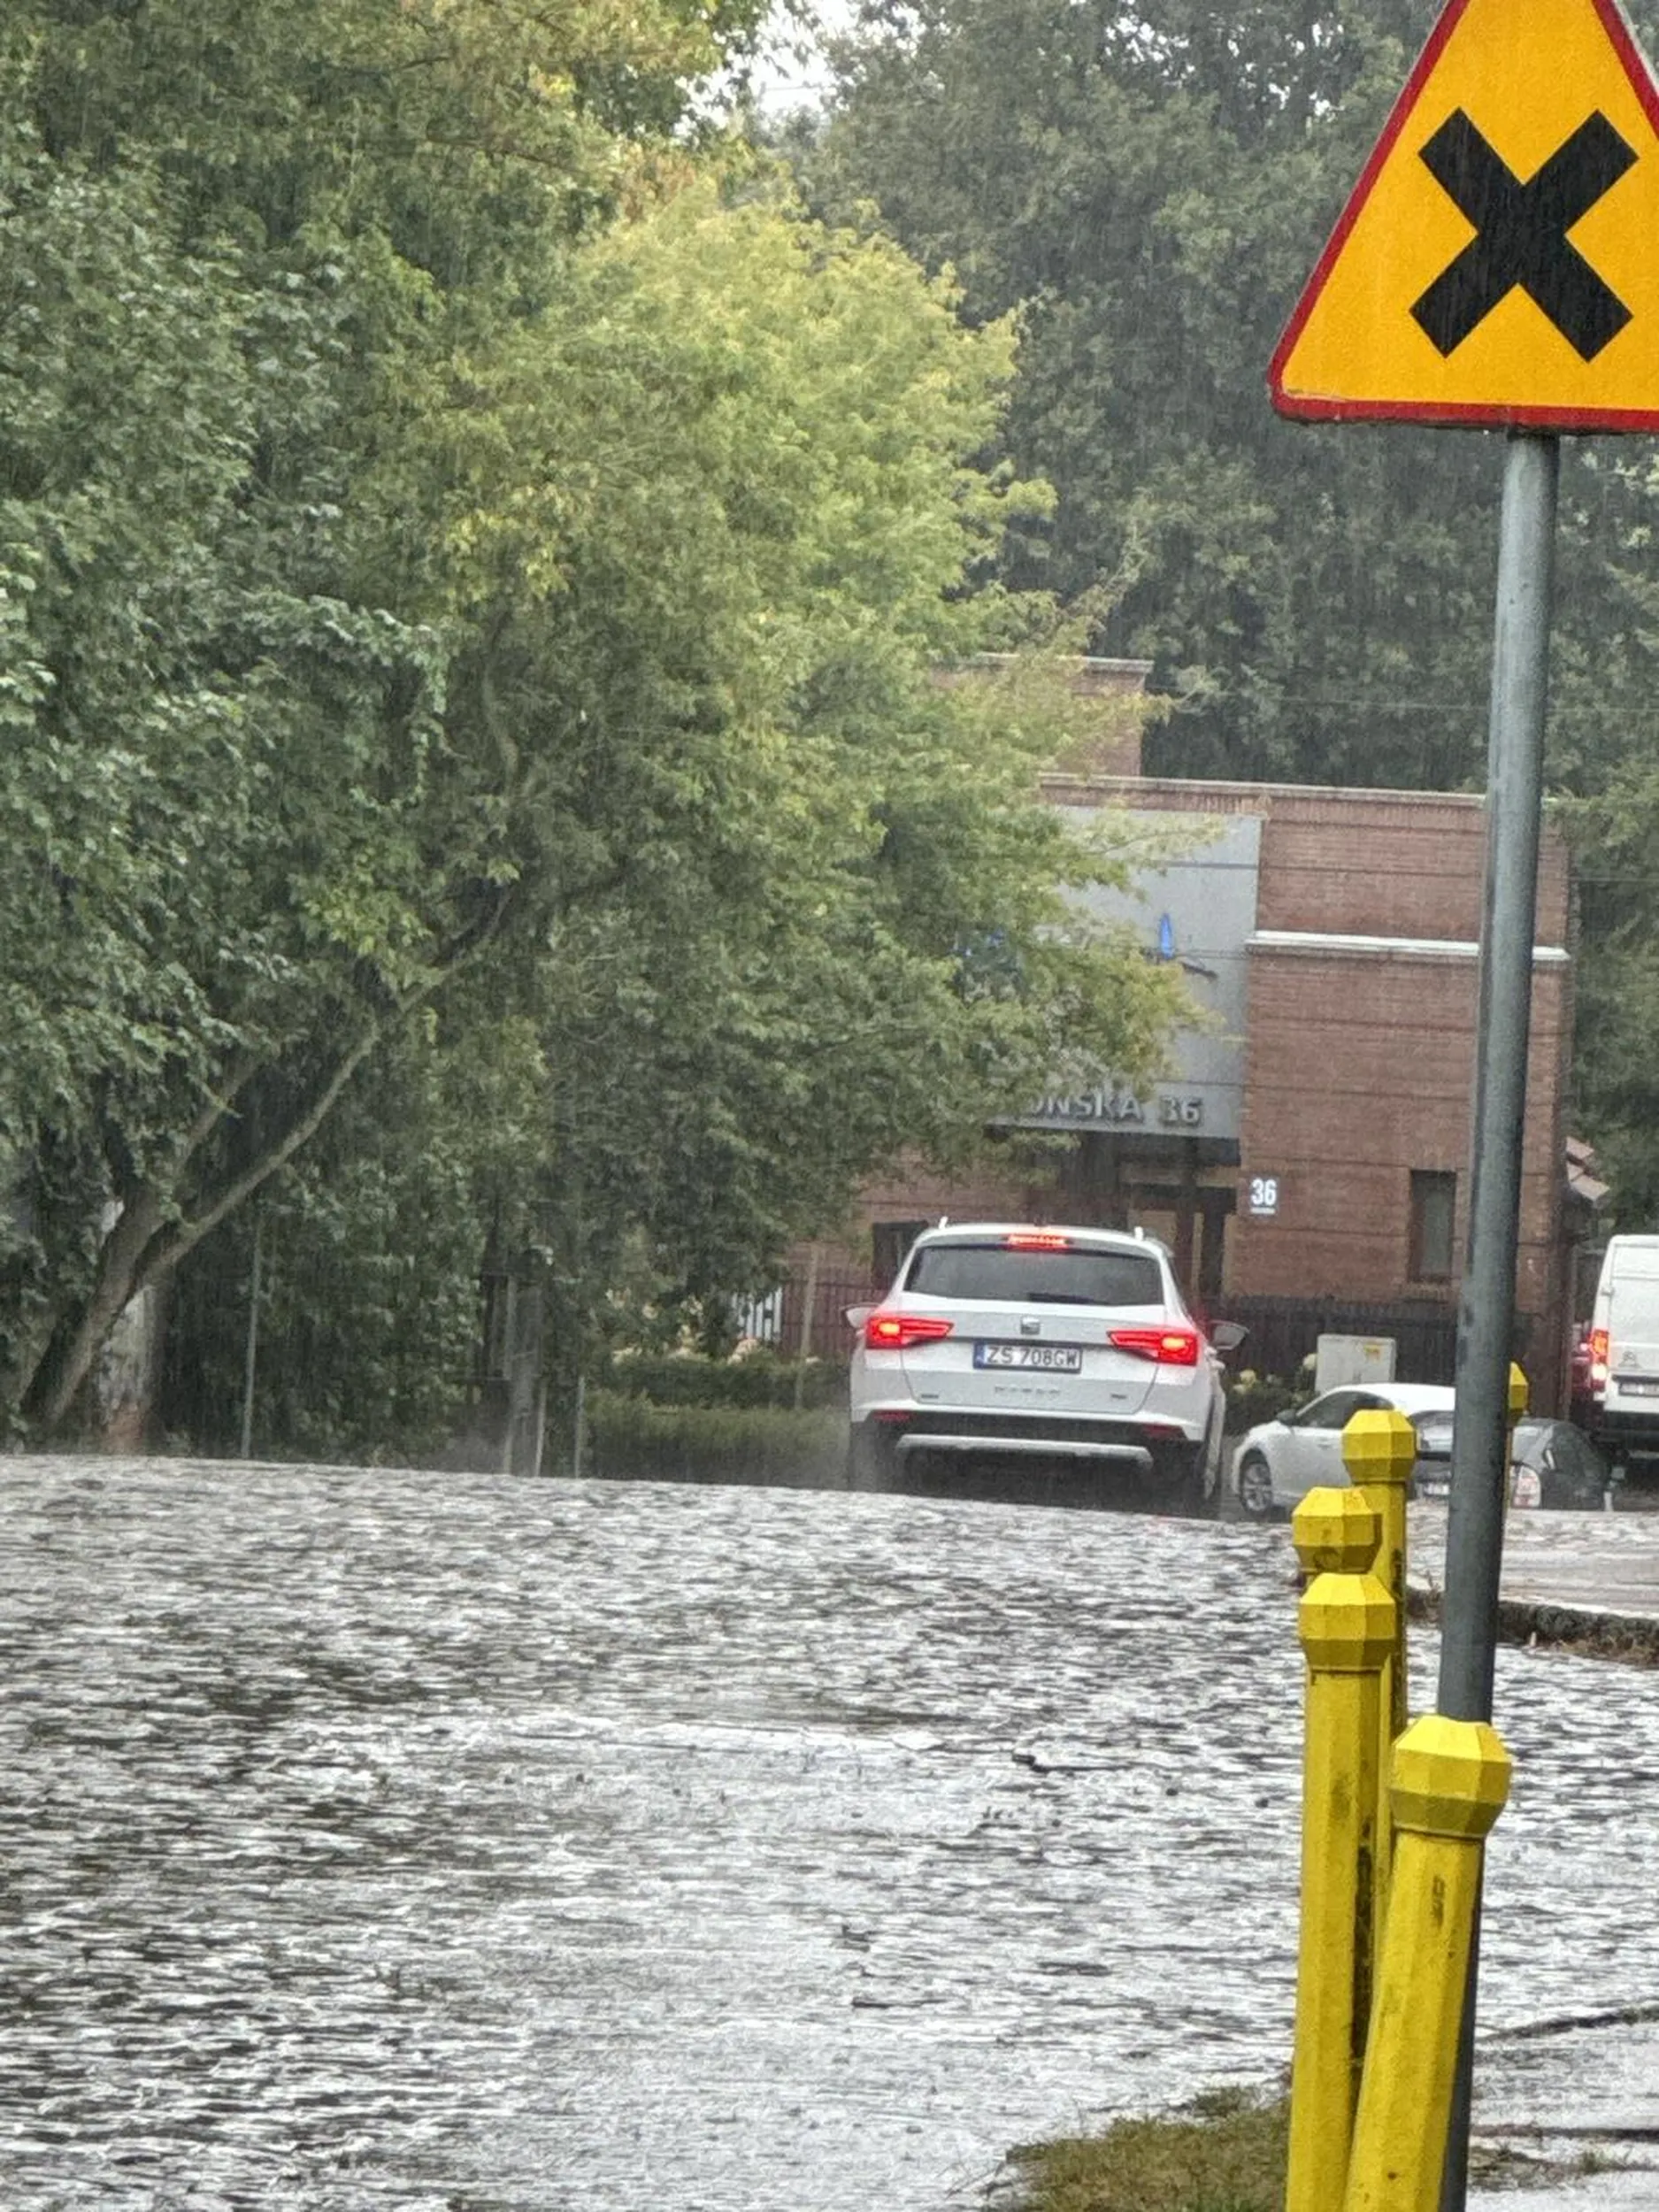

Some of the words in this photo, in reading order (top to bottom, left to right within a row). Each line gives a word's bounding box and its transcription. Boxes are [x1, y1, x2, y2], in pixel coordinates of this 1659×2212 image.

[1162, 1095, 1202, 1126] 36
[1251, 1178, 1277, 1205] 36
[987, 1346, 1013, 1363] ZS
